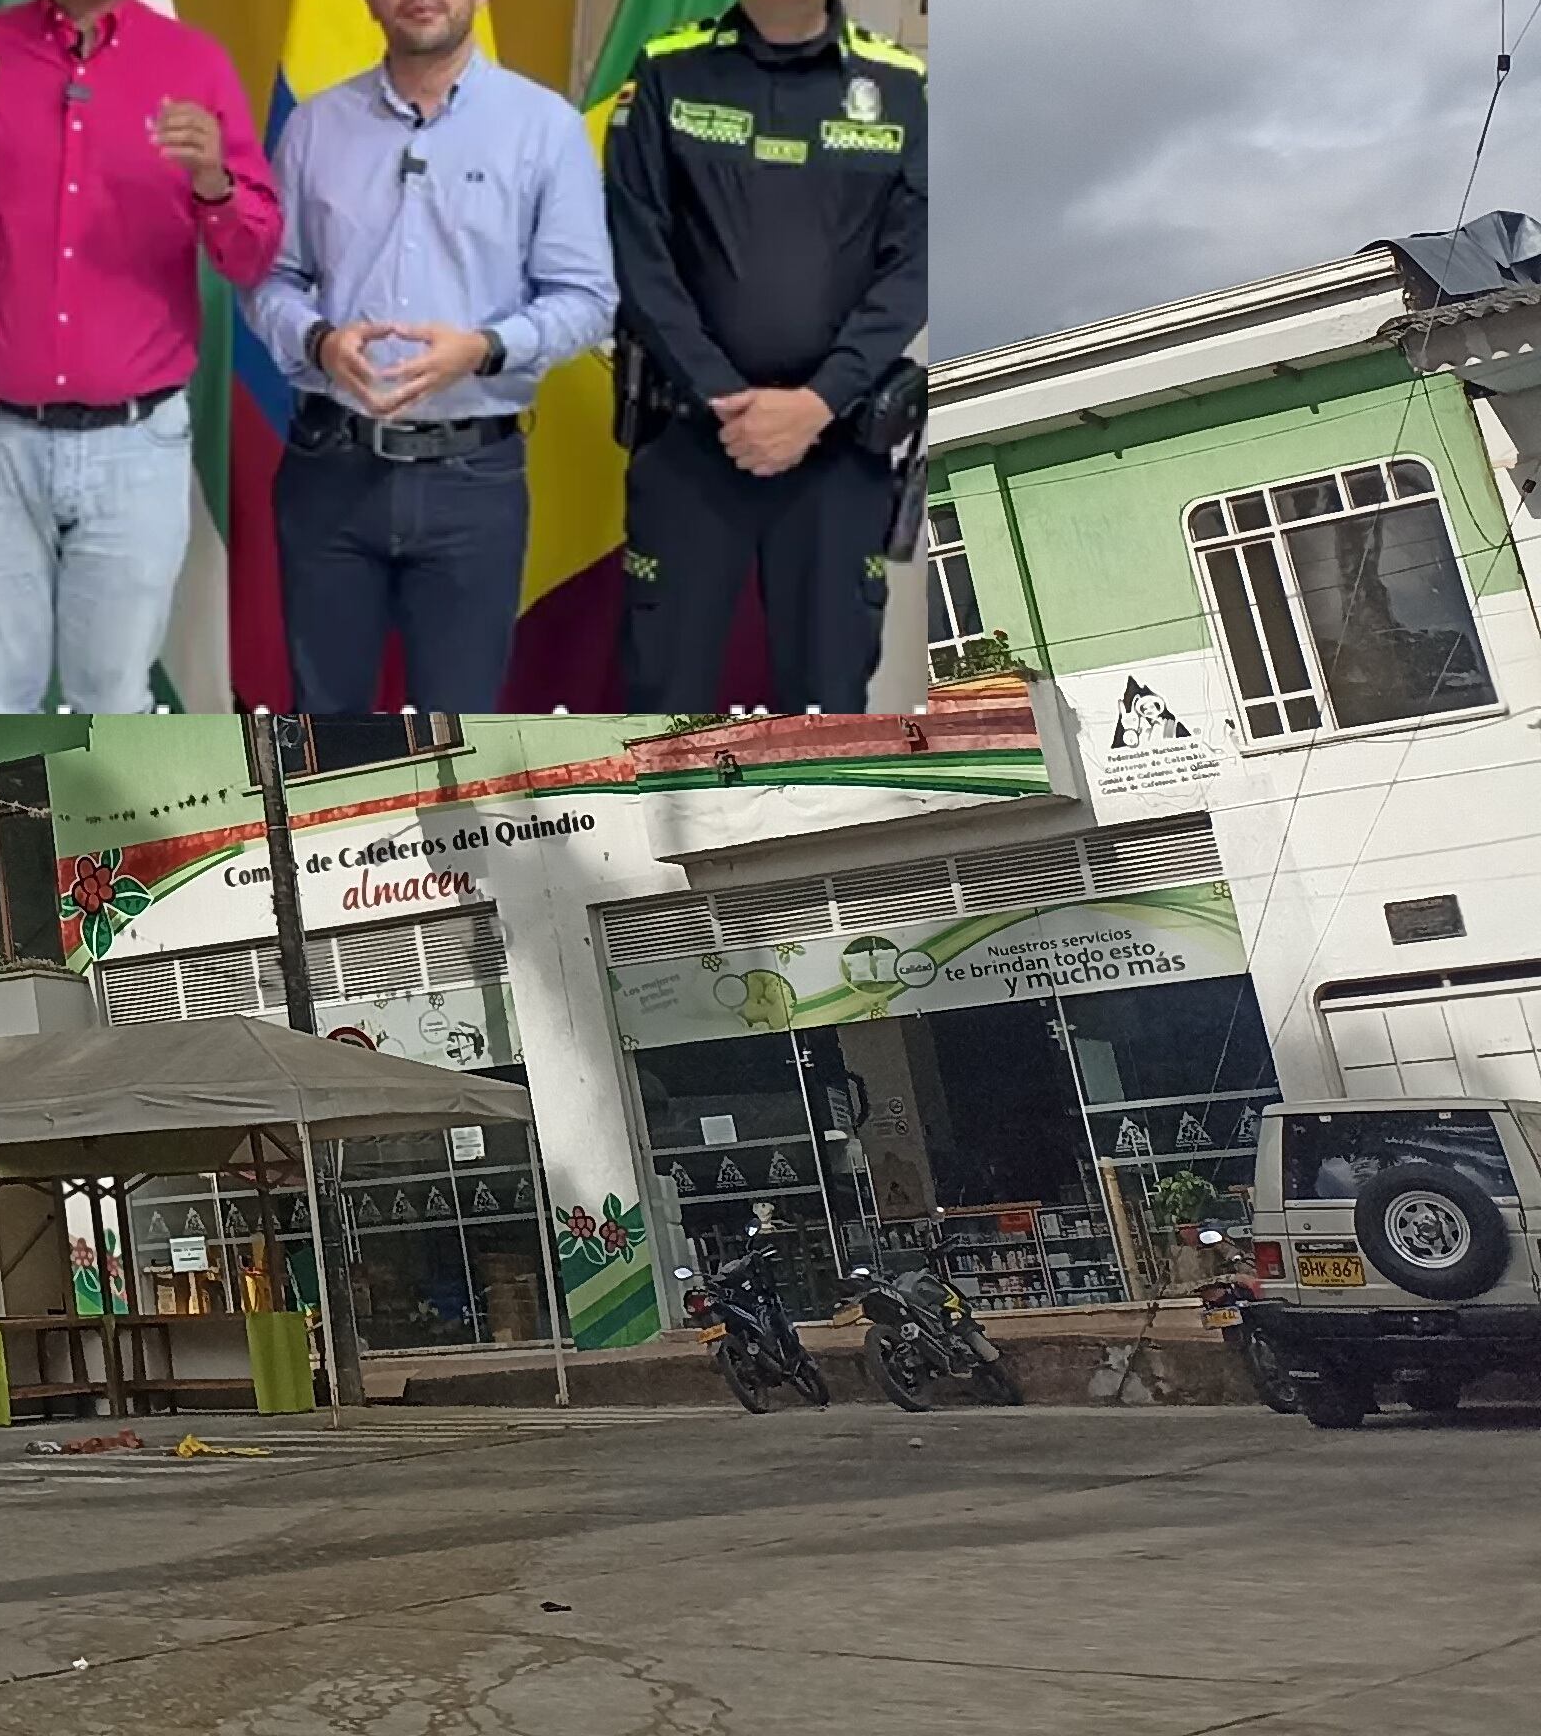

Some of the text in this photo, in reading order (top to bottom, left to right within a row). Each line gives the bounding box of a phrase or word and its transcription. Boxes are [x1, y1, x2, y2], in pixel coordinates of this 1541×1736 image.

[223, 864, 299, 888] Com
[305, 853, 333, 874] de
[338, 837, 447, 869] Cafeteros
[452, 825, 490, 851] del
[342, 864, 477, 911] almacén
[945, 942, 1156, 981] te brindan todo esto
[987, 928, 1132, 956] Nuestros servicios
[1004, 950, 1186, 998] y mucho más
[1332, 1259, 1359, 1277] 867
